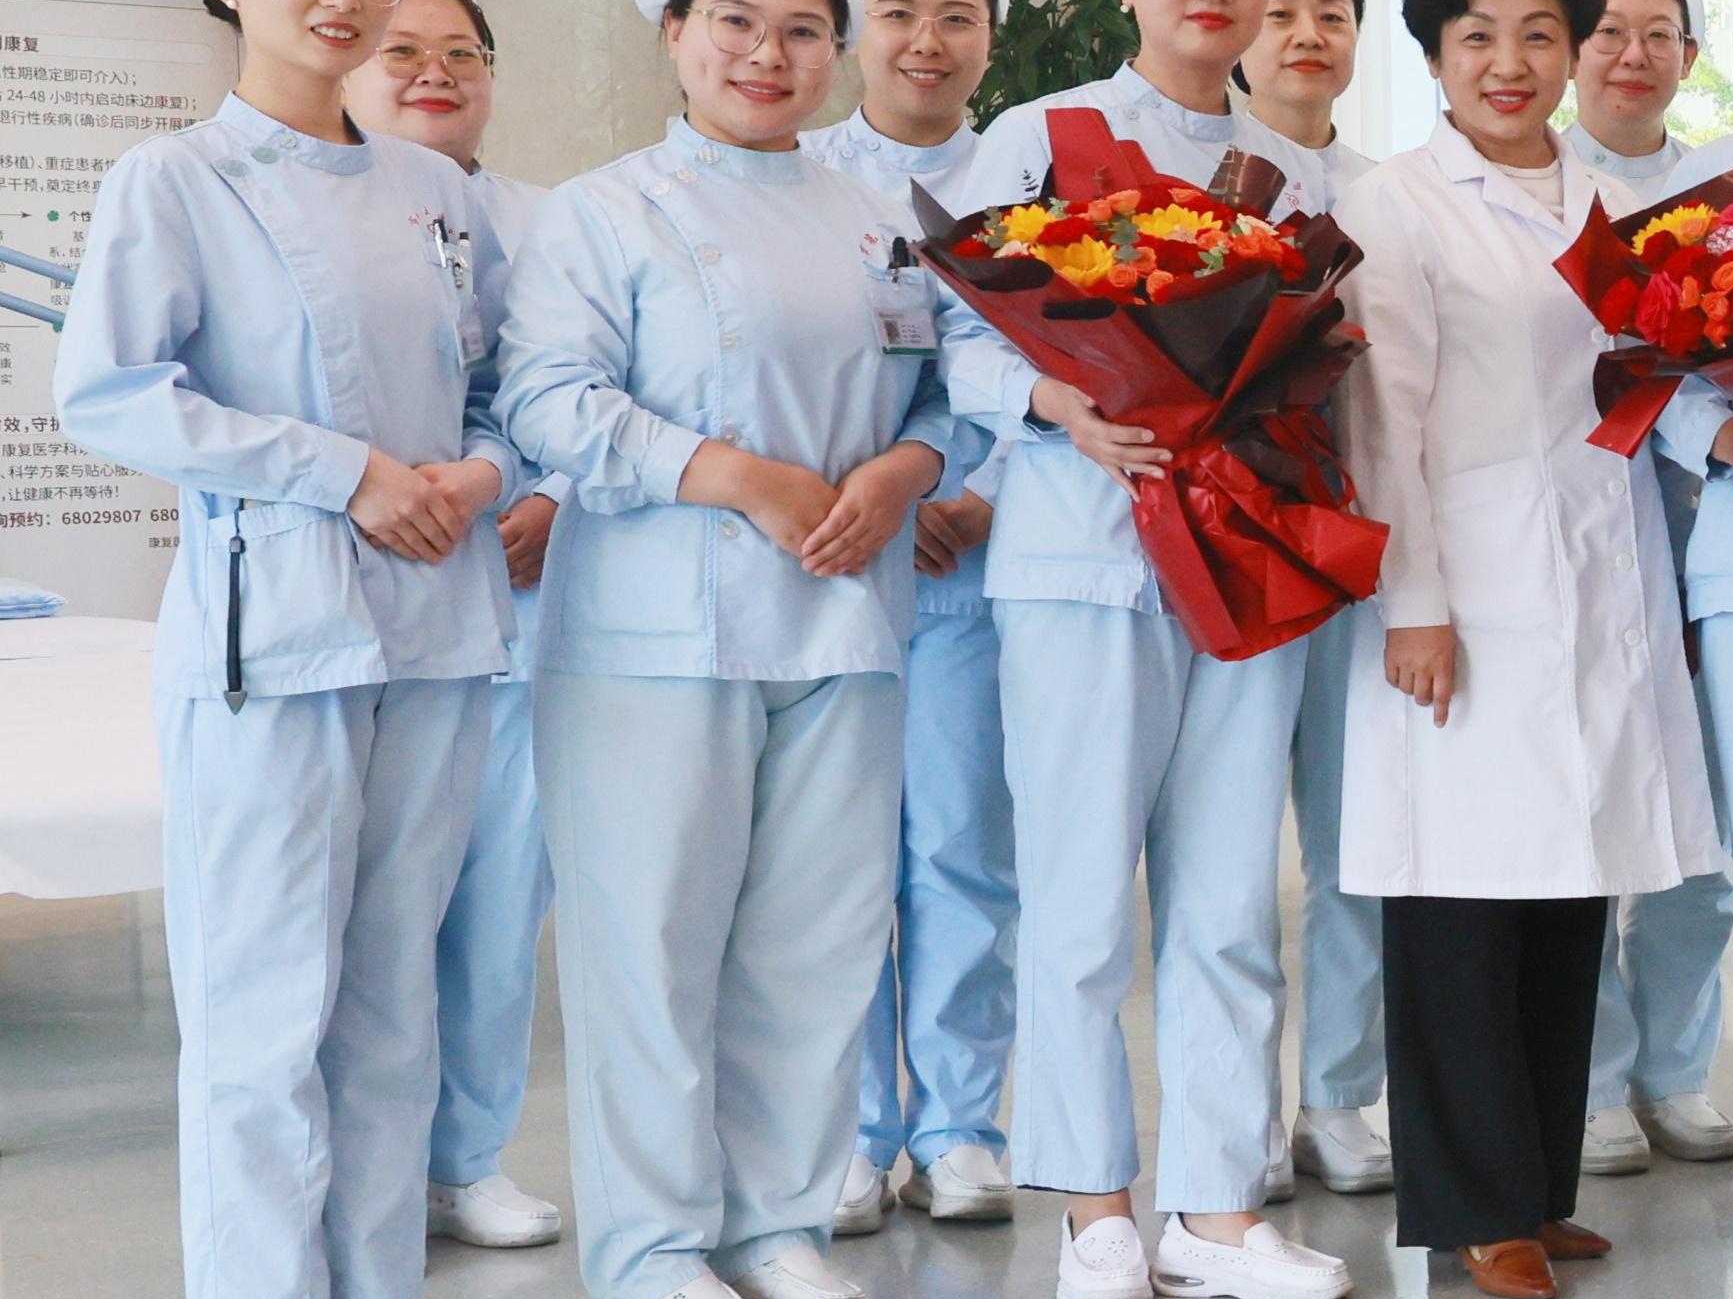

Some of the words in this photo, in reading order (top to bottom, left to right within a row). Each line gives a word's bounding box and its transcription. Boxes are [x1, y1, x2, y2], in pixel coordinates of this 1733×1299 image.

[0, 35, 39, 53] 康复
[0, 65, 137, 86] 性期稳定即可介入）；
[0, 416, 60, 433] 效，守
[62, 509, 142, 525] 68029807
